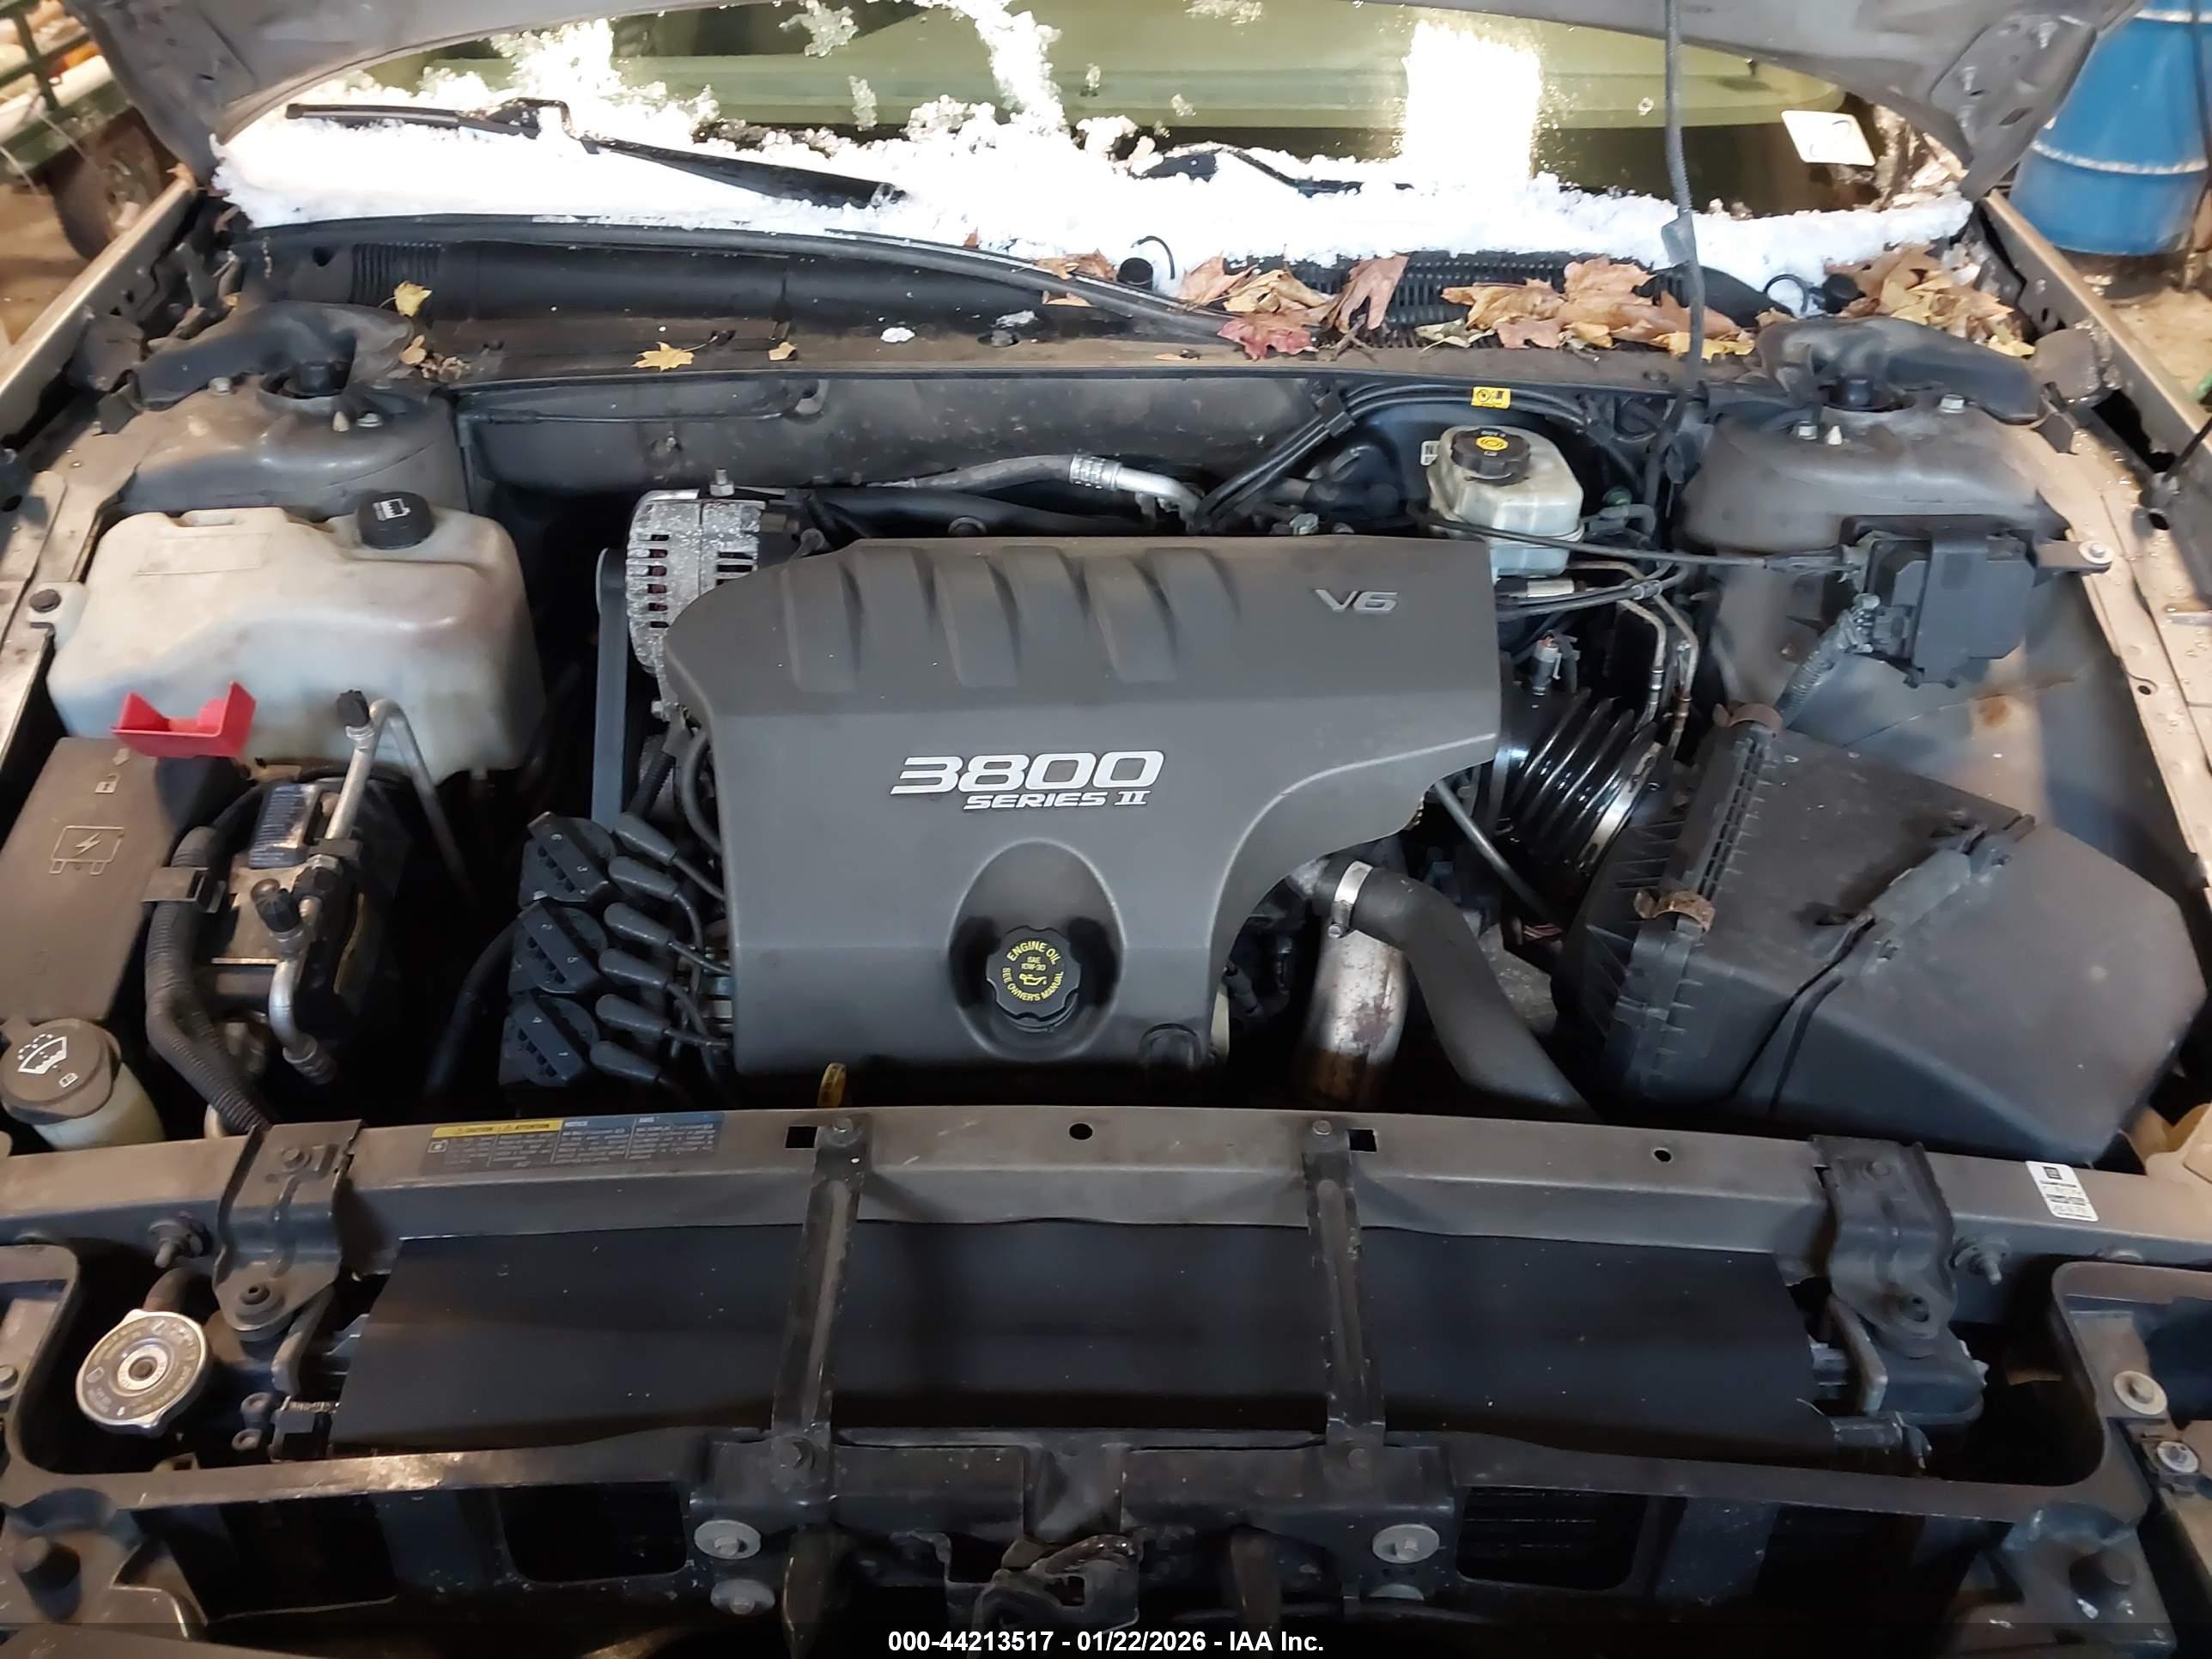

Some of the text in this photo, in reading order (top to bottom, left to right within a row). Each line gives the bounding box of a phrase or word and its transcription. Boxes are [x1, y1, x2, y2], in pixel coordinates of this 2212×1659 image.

[1315, 589, 1398, 611] V6
[890, 750, 1164, 794] 3800
[963, 790, 1151, 810] SERIES II
[1006, 940, 1061, 965] ENGINE OIL
